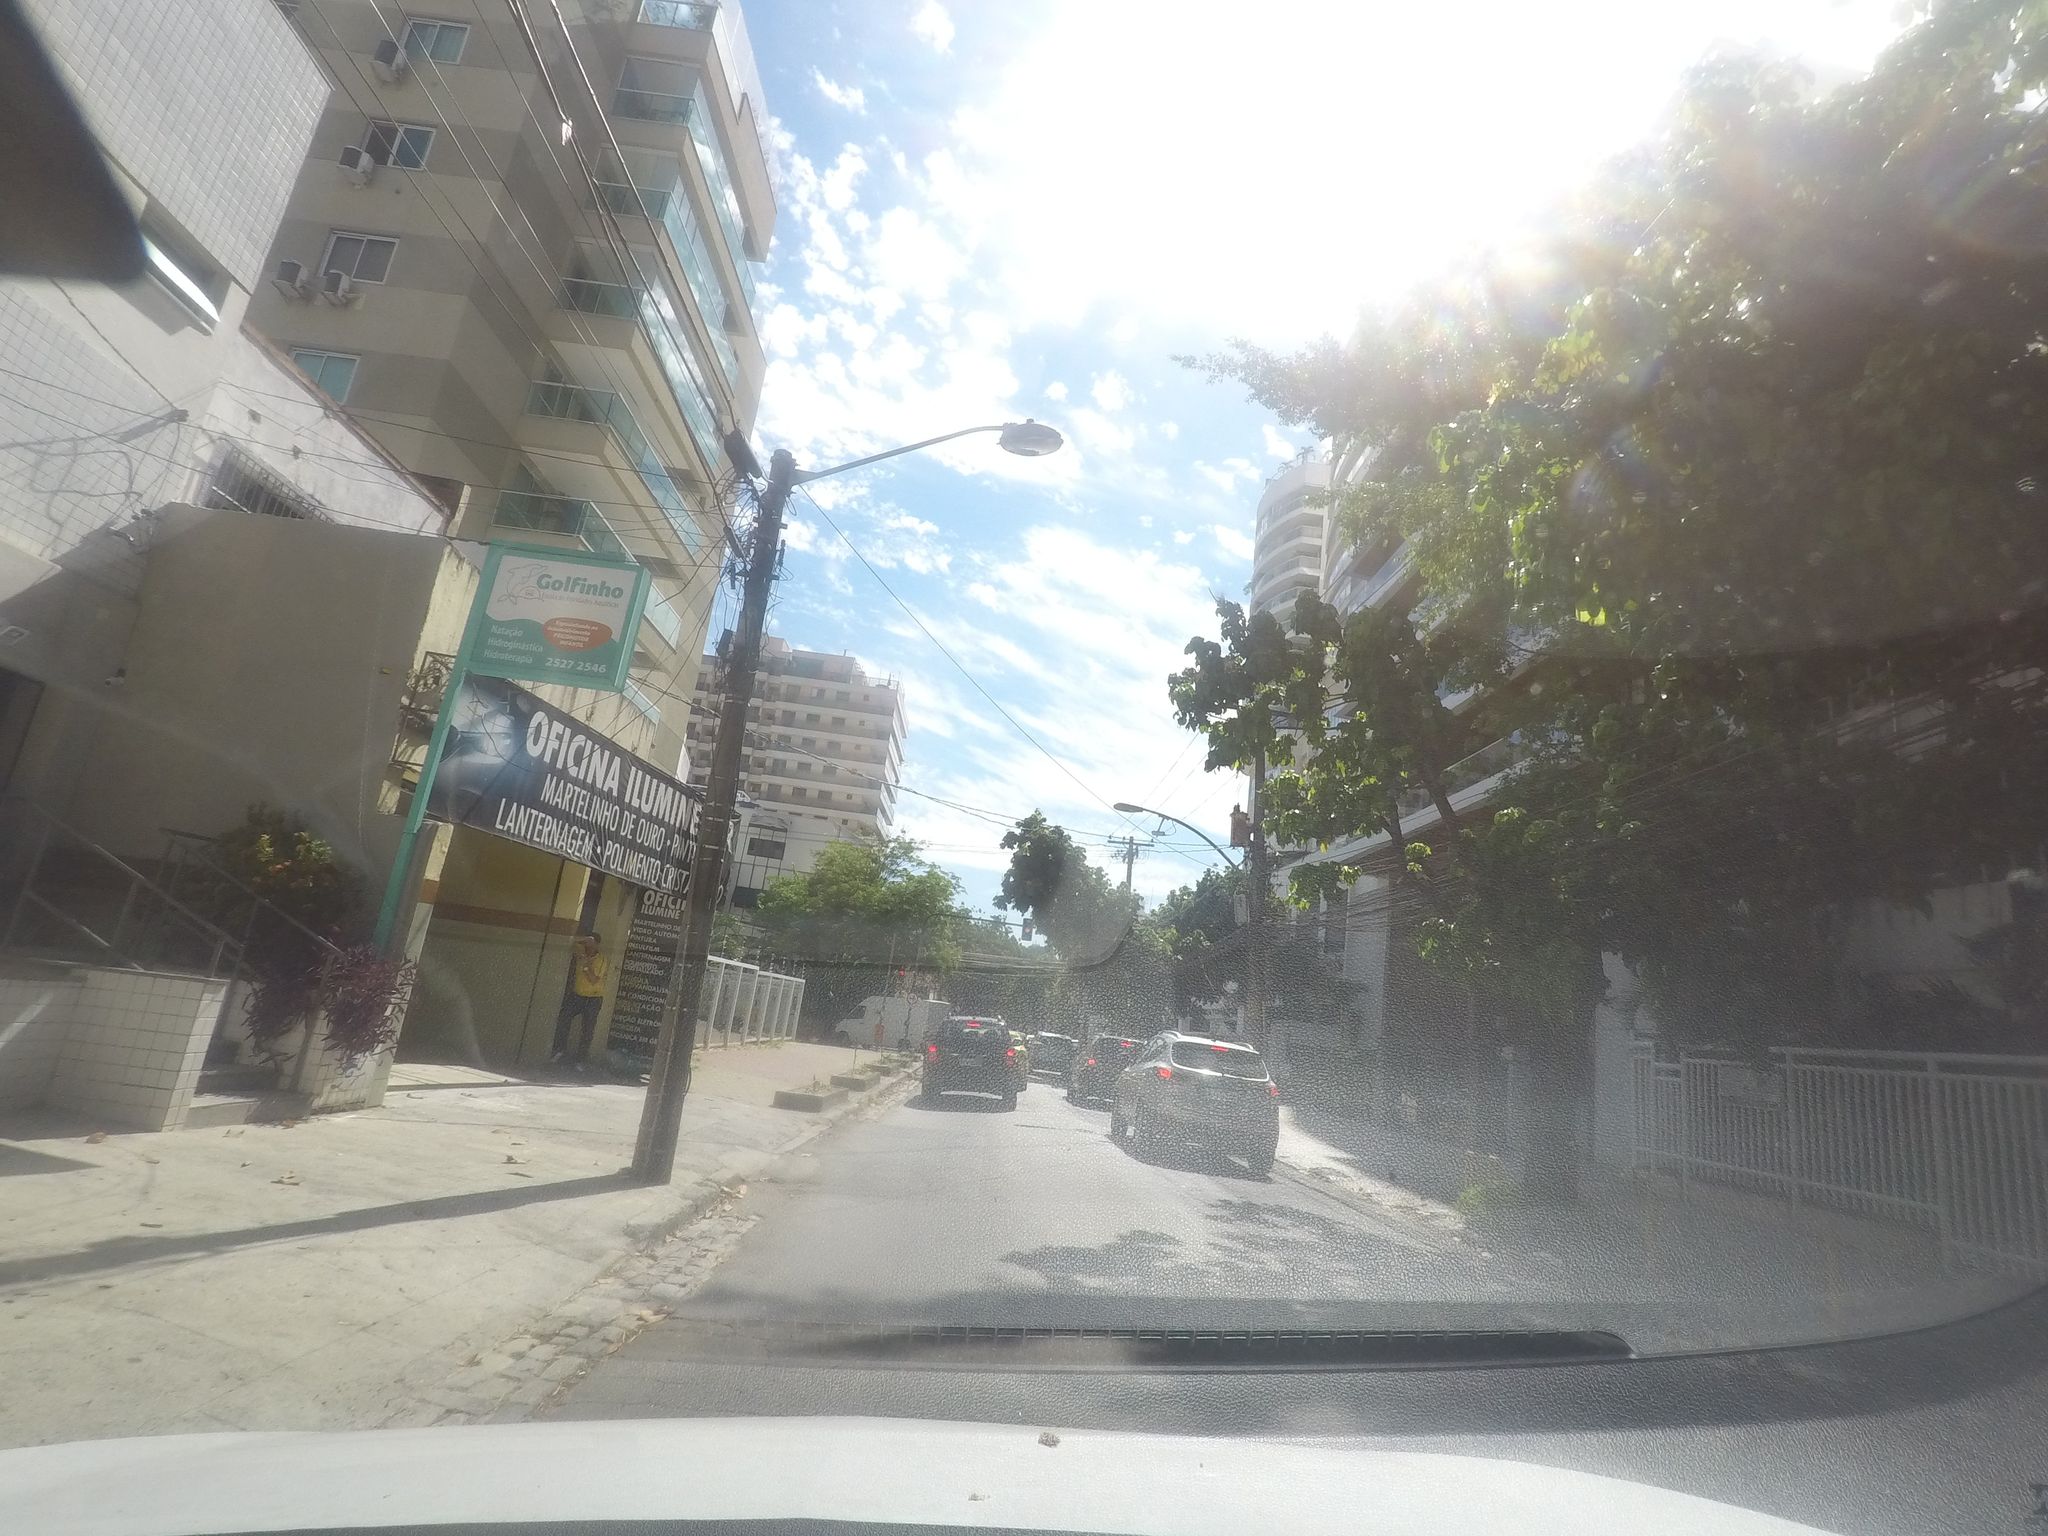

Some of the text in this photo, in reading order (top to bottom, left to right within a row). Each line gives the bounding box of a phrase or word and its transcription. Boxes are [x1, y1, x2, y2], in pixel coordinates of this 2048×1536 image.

[536, 573, 624, 599] Golfinho
[490, 625, 524, 638] Natação
[487, 638, 543, 653] Hidroginástica
[484, 649, 533, 664] Hidroterapia
[545, 657, 607, 673] 2527 2546
[526, 711, 621, 796] OFICINA
[540, 773, 620, 832] MARTELINHO
[620, 810, 637, 839] DE
[637, 818, 666, 851] OURO
[495, 798, 595, 860] LANTERNAGEM
[602, 840, 661, 884] POLIMENTO
